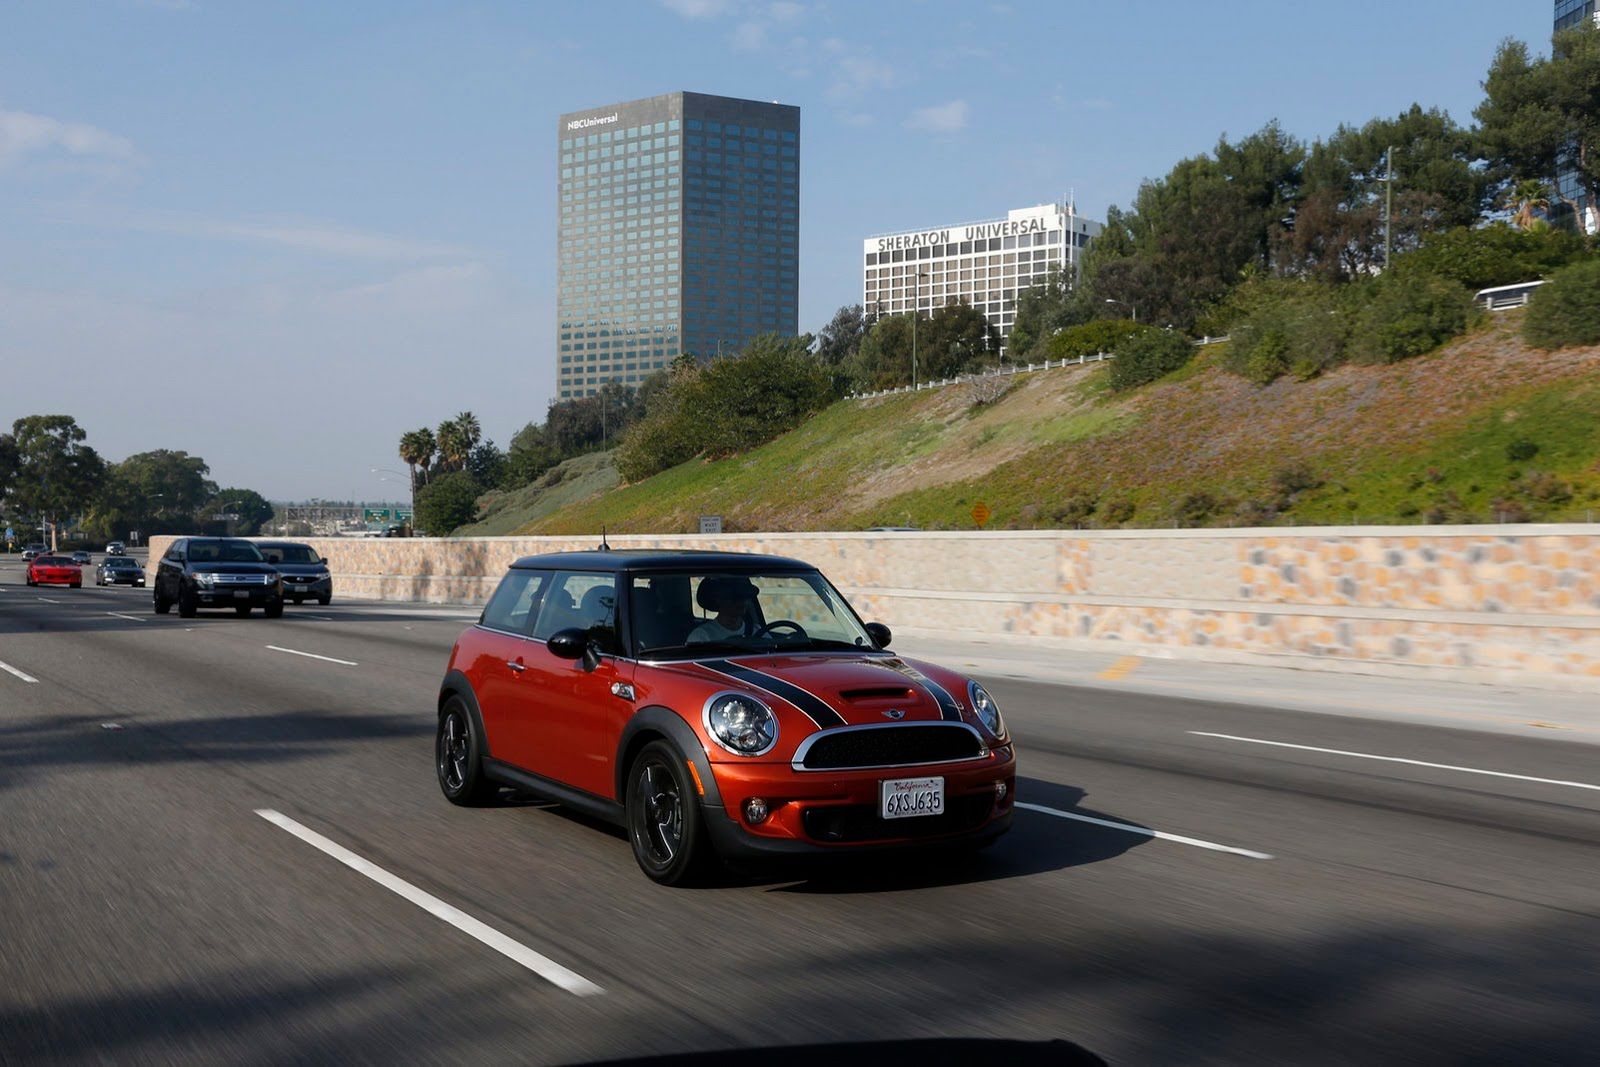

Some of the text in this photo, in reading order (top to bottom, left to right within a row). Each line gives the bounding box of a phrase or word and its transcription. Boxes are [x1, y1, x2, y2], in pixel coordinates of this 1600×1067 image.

[567, 112, 618, 131] NBCUniversal
[878, 217, 1047, 252] SHERATON UNIVERSAL
[887, 791, 940, 813] 6XSJ635
